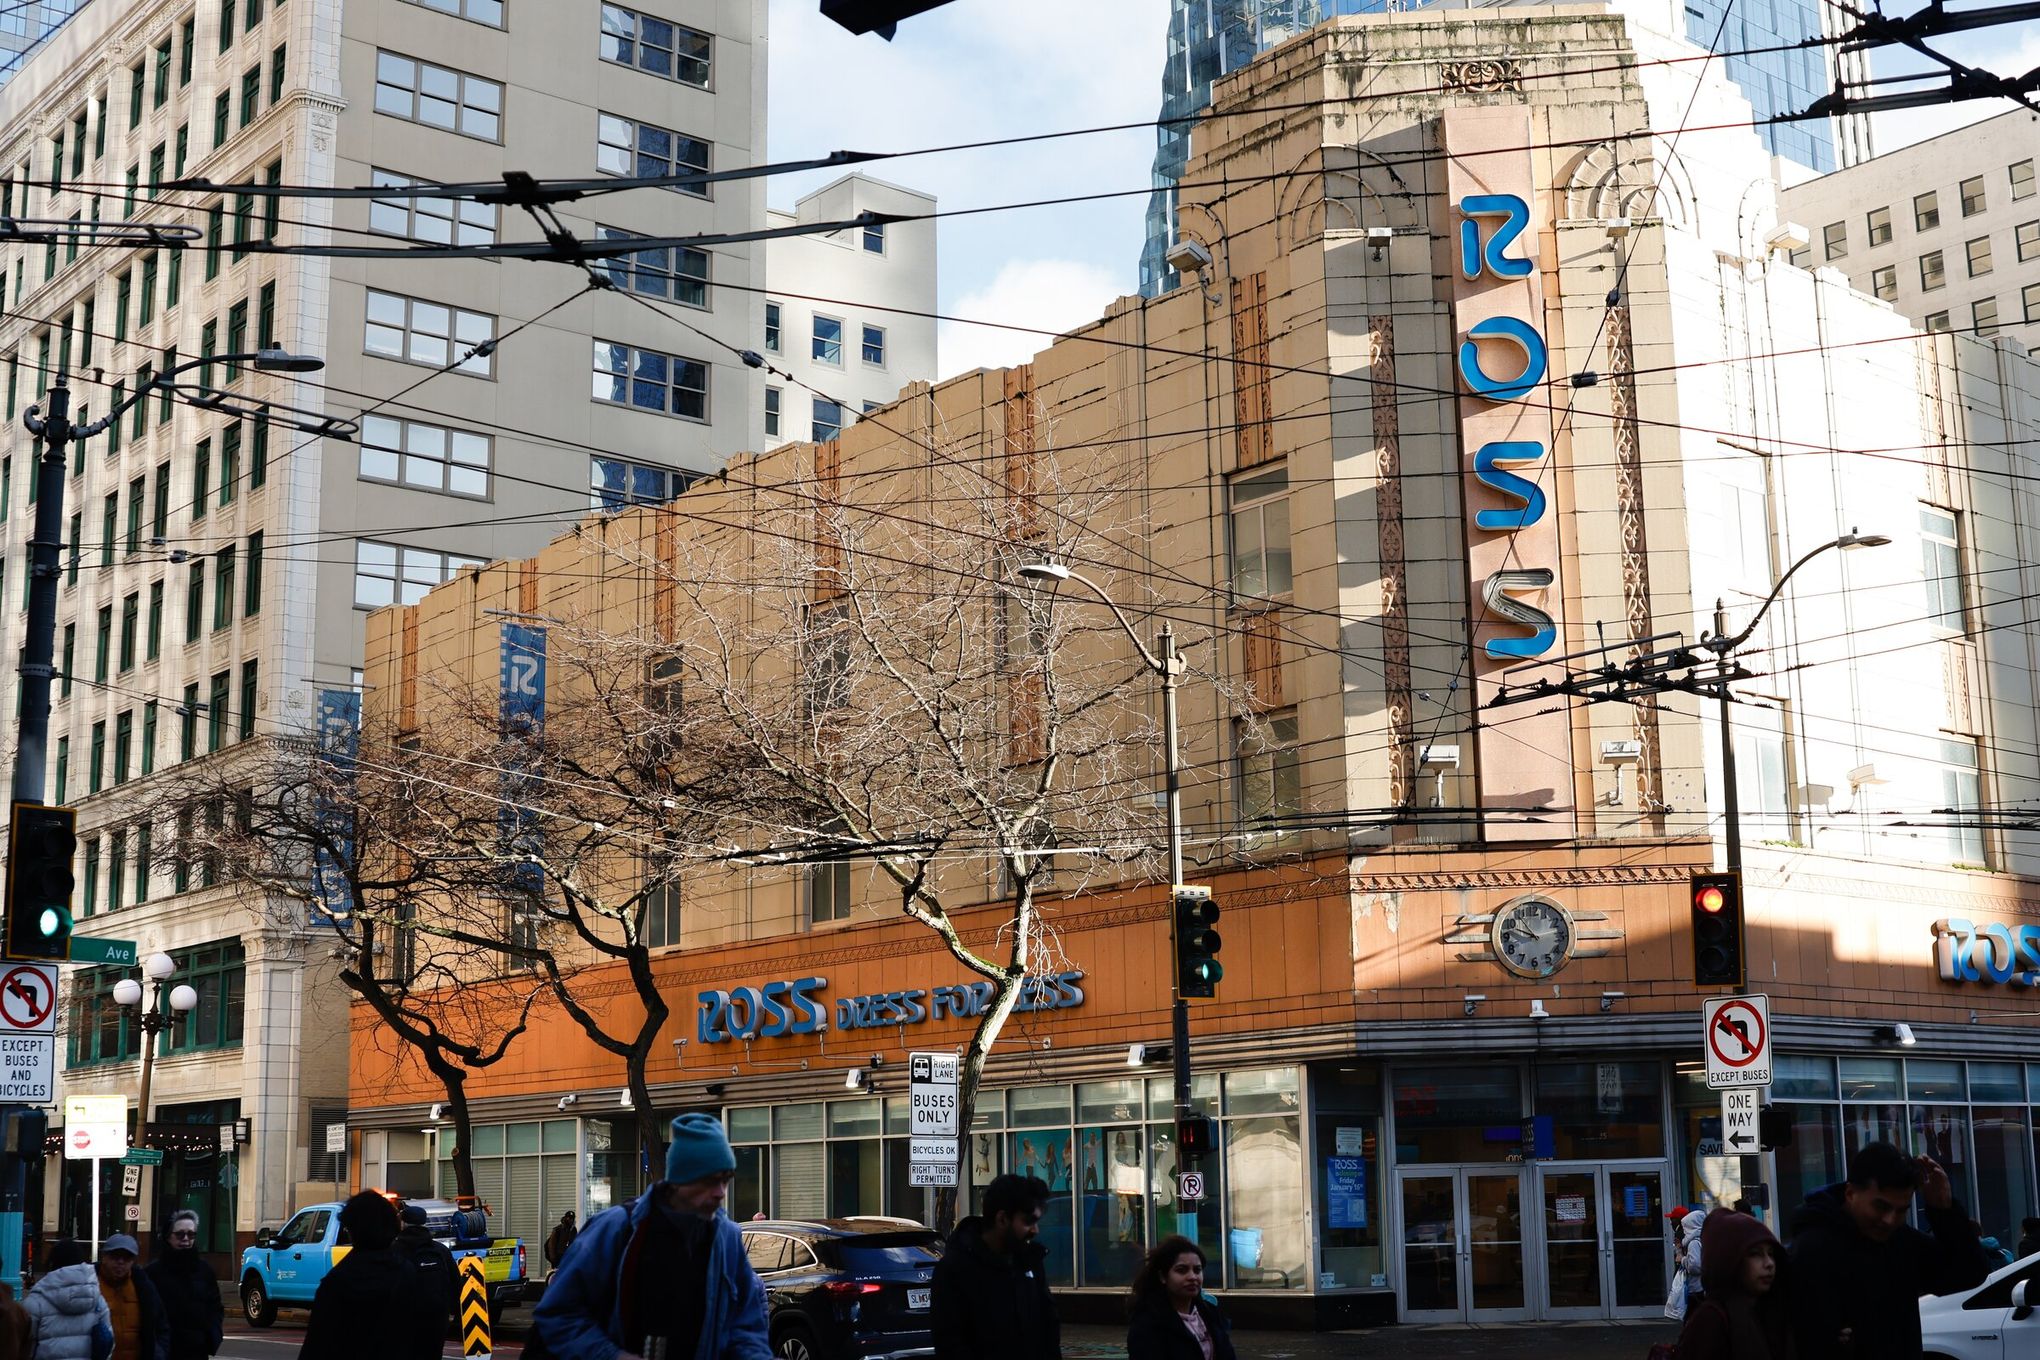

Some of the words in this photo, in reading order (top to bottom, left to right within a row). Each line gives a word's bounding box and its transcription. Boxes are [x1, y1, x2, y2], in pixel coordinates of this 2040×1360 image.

[1458, 194, 1557, 660] ROSS
[105, 946, 129, 960] Ave
[697, 976, 828, 1044] ROSS
[836, 989, 926, 1030] DRESS
[931, 980, 998, 1020] FOR
[1011, 970, 1085, 1013] ESS
[2, 1039, 43, 1052] EXCEPT
[5, 1055, 39, 1067] BUSES
[933, 1060, 954, 1069] RIGHT
[11, 1069, 31, 1081] AND
[935, 1070, 954, 1079] LANE
[1711, 1071, 1739, 1083] EXCEPT
[1742, 1069, 1768, 1080] BUSES
[914, 1094, 954, 1108] BUSES
[1728, 1095, 1752, 1109] ONE
[918, 1110, 949, 1123] ONLY
[1728, 1112, 1753, 1127] WAY
[912, 1146, 944, 1155] BICYCLES
[946, 1146, 956, 1155] OK
[1335, 1159, 1358, 1169] ROSS
[126, 1168, 138, 1176] ONE
[912, 1166, 931, 1175] RIGHT
[935, 1166, 955, 1175] TURNS
[125, 1176, 137, 1184] WAY
[916, 1174, 952, 1184] PERMITTED
